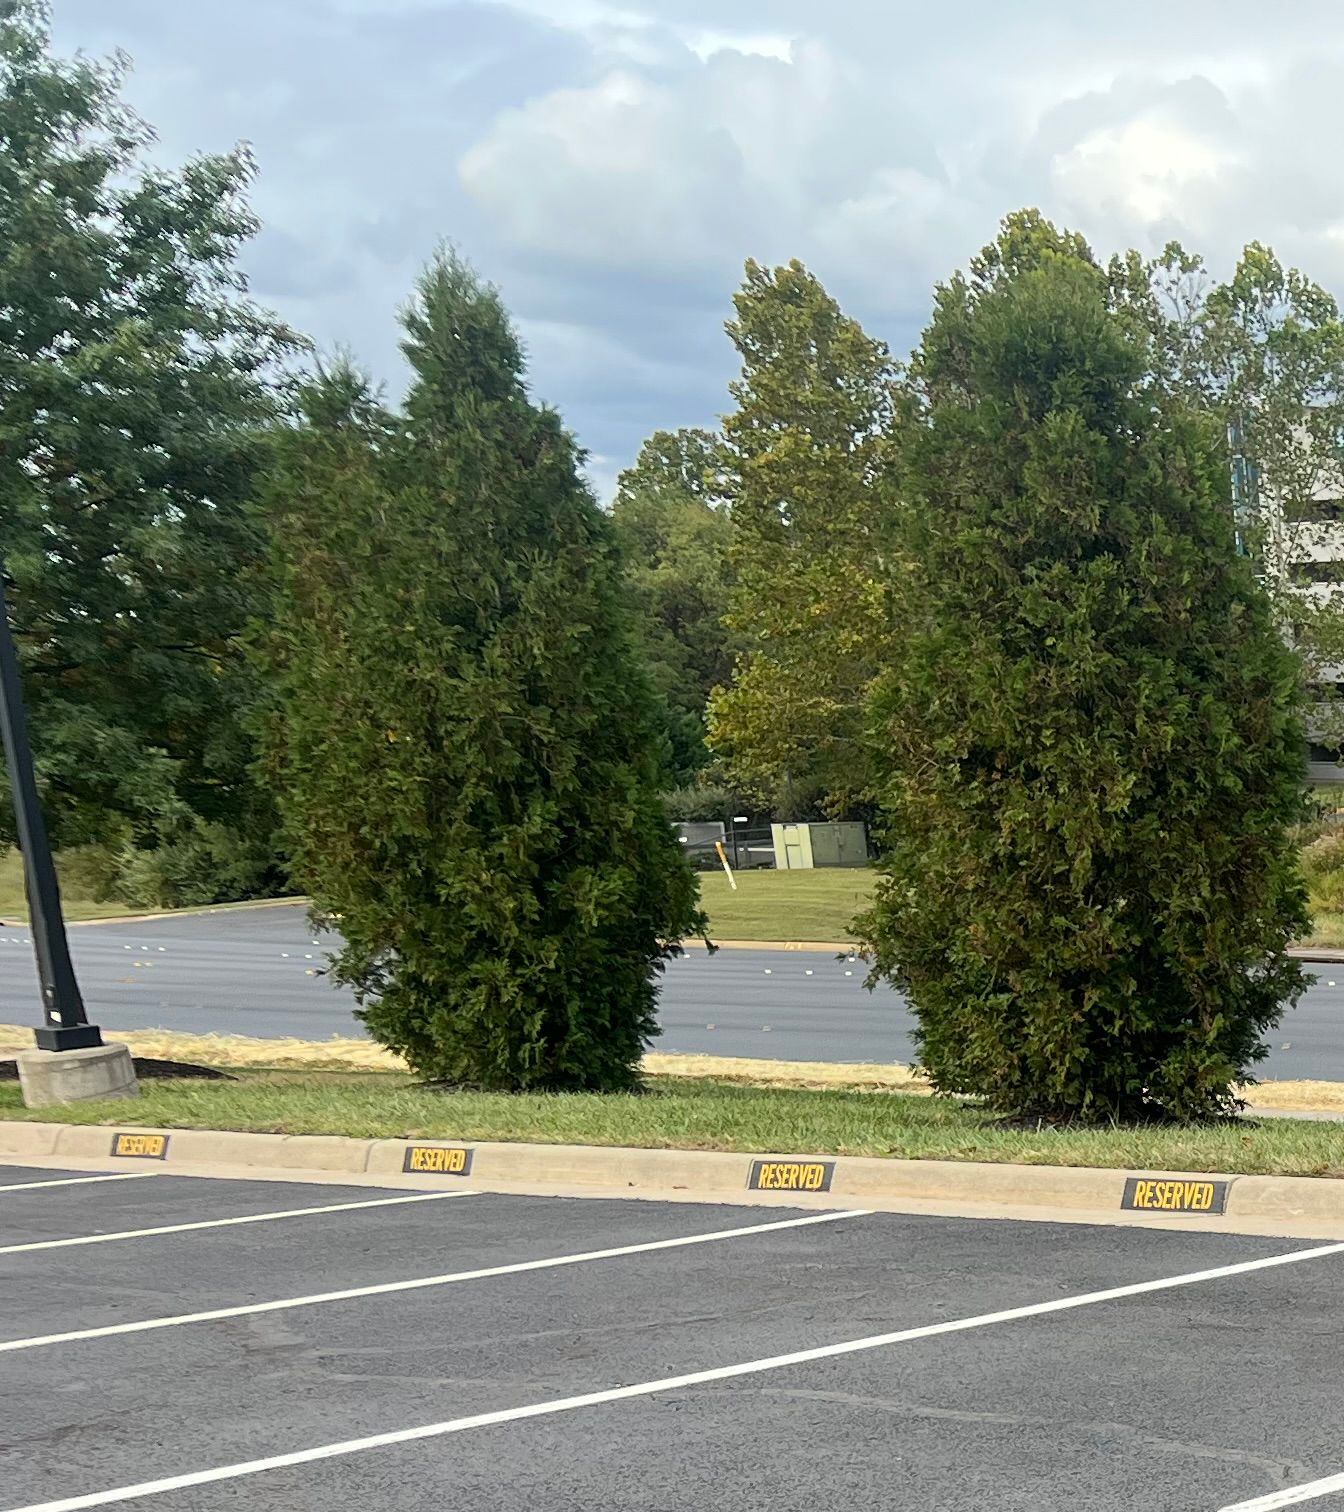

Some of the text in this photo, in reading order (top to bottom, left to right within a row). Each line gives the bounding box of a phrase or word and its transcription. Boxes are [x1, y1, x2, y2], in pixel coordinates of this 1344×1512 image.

[410, 1148, 466, 1172] RESERVED
[758, 1163, 824, 1189] RESERVED
[1133, 1180, 1214, 1210] RESERVED
